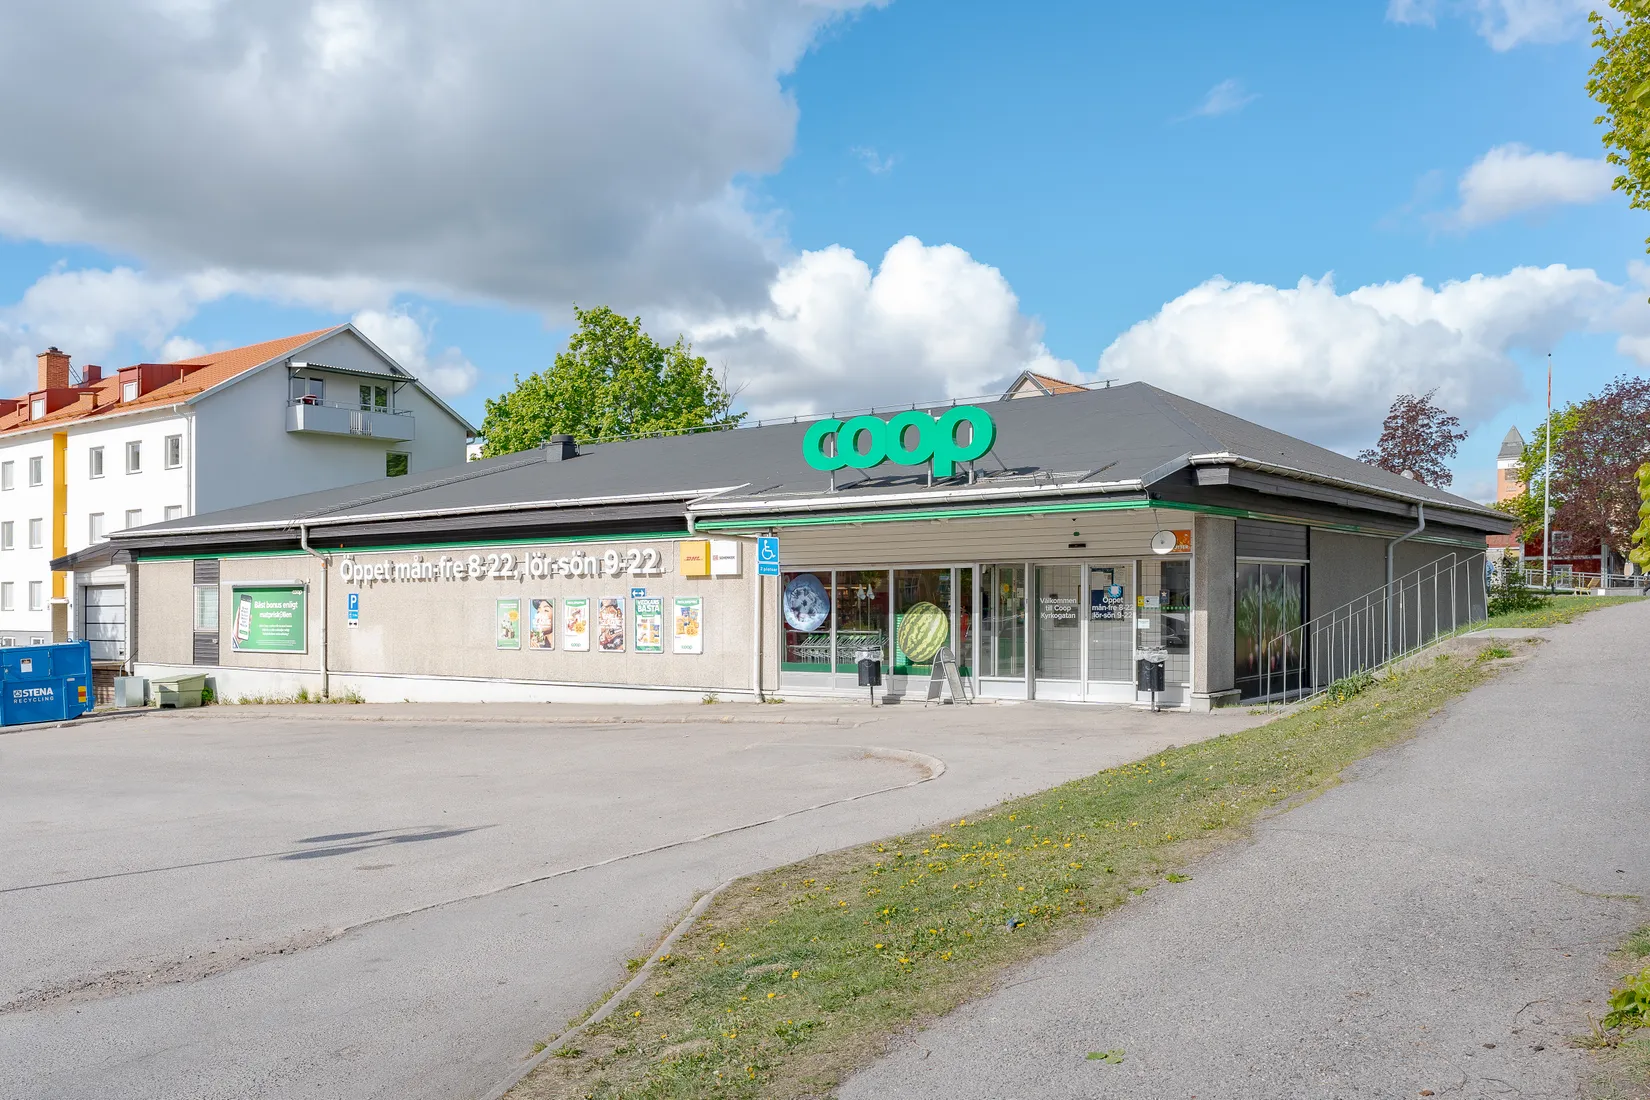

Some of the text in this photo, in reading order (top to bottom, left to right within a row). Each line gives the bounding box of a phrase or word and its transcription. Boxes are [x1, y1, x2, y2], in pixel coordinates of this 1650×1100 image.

[802, 405, 996, 477] coop
[340, 554, 391, 585] Öppet
[395, 555, 464, 579] mån-fre
[468, 553, 518, 580] 8-22,
[525, 551, 599, 576] lör-sön
[351, 595, 357, 609] P
[1102, 595, 1124, 604] Öppet
[266, 601, 282, 609] bonus
[283, 601, 298, 610] enligt
[1054, 604, 1071, 612] Coop
[1091, 603, 1134, 611] mån-fre 8-22
[1040, 612, 1076, 620] Kyrkogatan
[23, 687, 54, 697] STENA
[13, 696, 54, 704] RECYCLING
